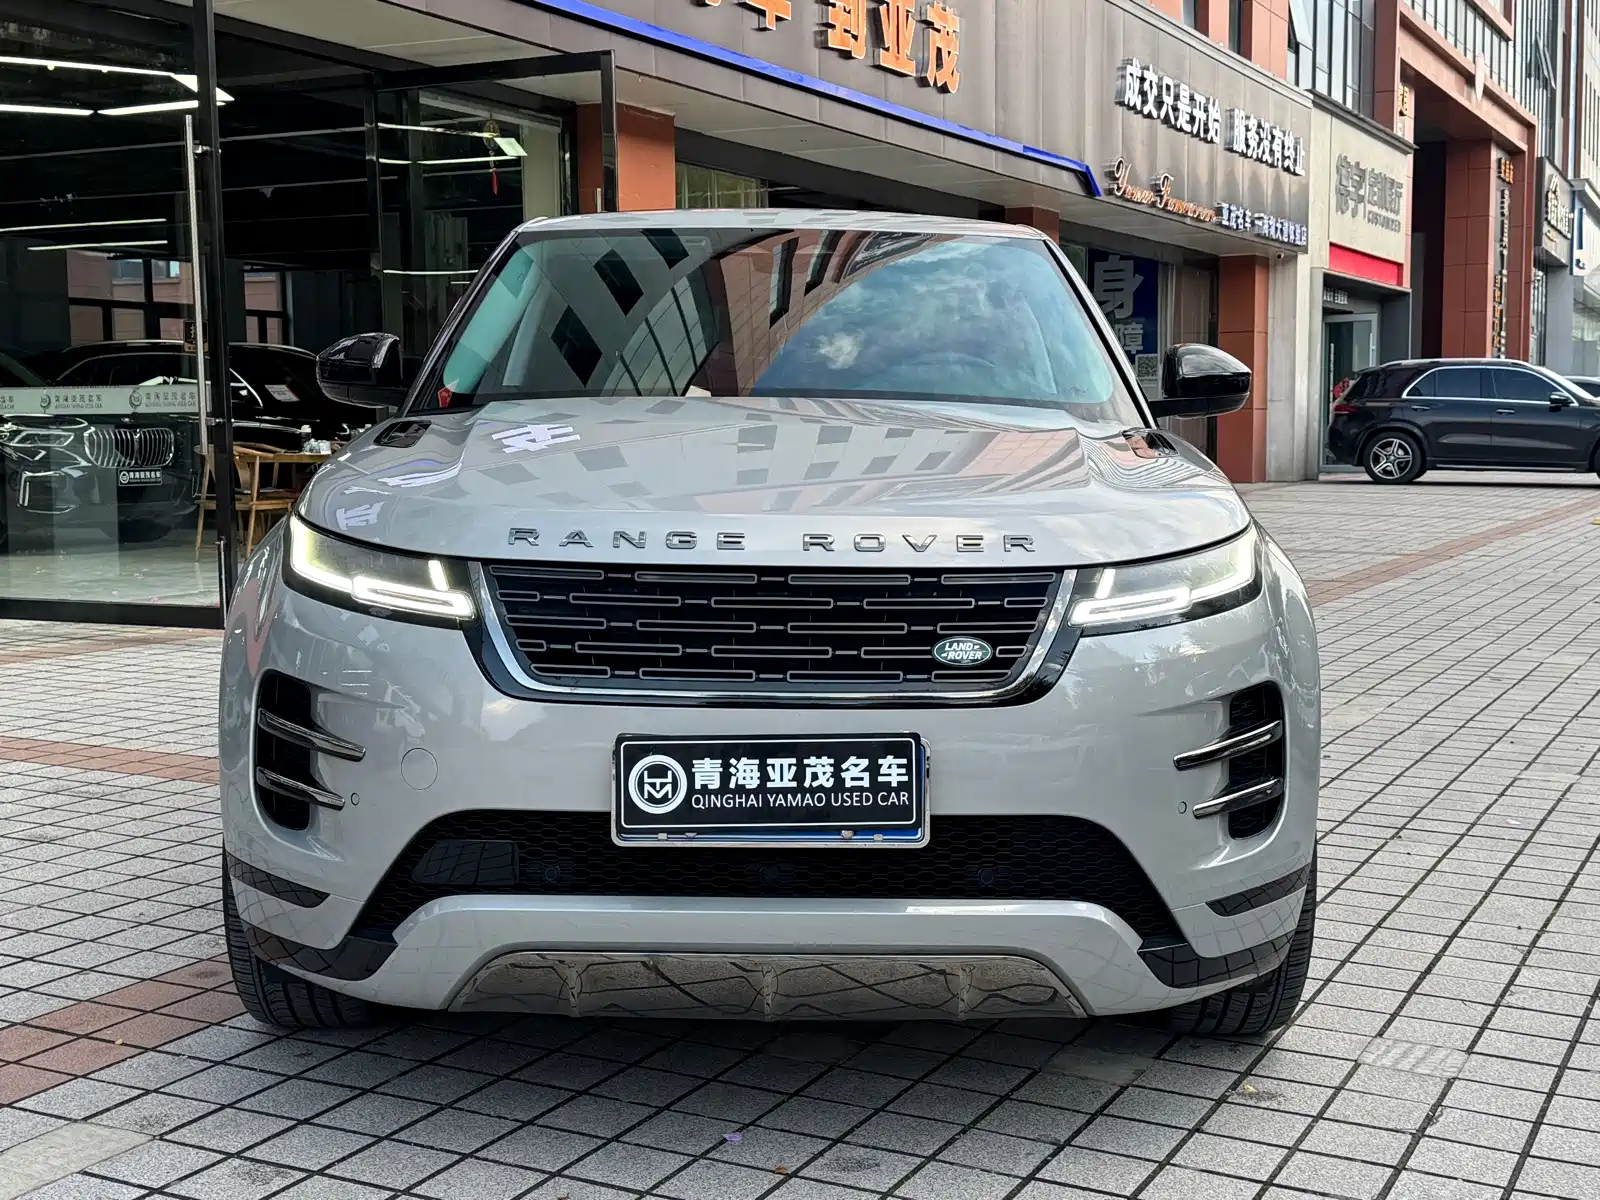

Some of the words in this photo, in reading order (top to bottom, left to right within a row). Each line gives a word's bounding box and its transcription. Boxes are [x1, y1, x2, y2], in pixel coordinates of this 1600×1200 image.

[1124, 57, 1222, 144] 成交只是开始
[1233, 108, 1306, 177] 服务没有终止
[1092, 254, 1145, 319] 身
[508, 527, 745, 551] RANGE
[802, 532, 1036, 553] ROVER
[944, 642, 974, 651] LAND
[947, 651, 983, 660] ROVER
[691, 755, 909, 790] 青海亚茂名车
[691, 793, 763, 809] QINGHAI
[767, 793, 826, 808] YAMAO
[831, 792, 873, 807] USED
[877, 791, 909, 806] CAR
